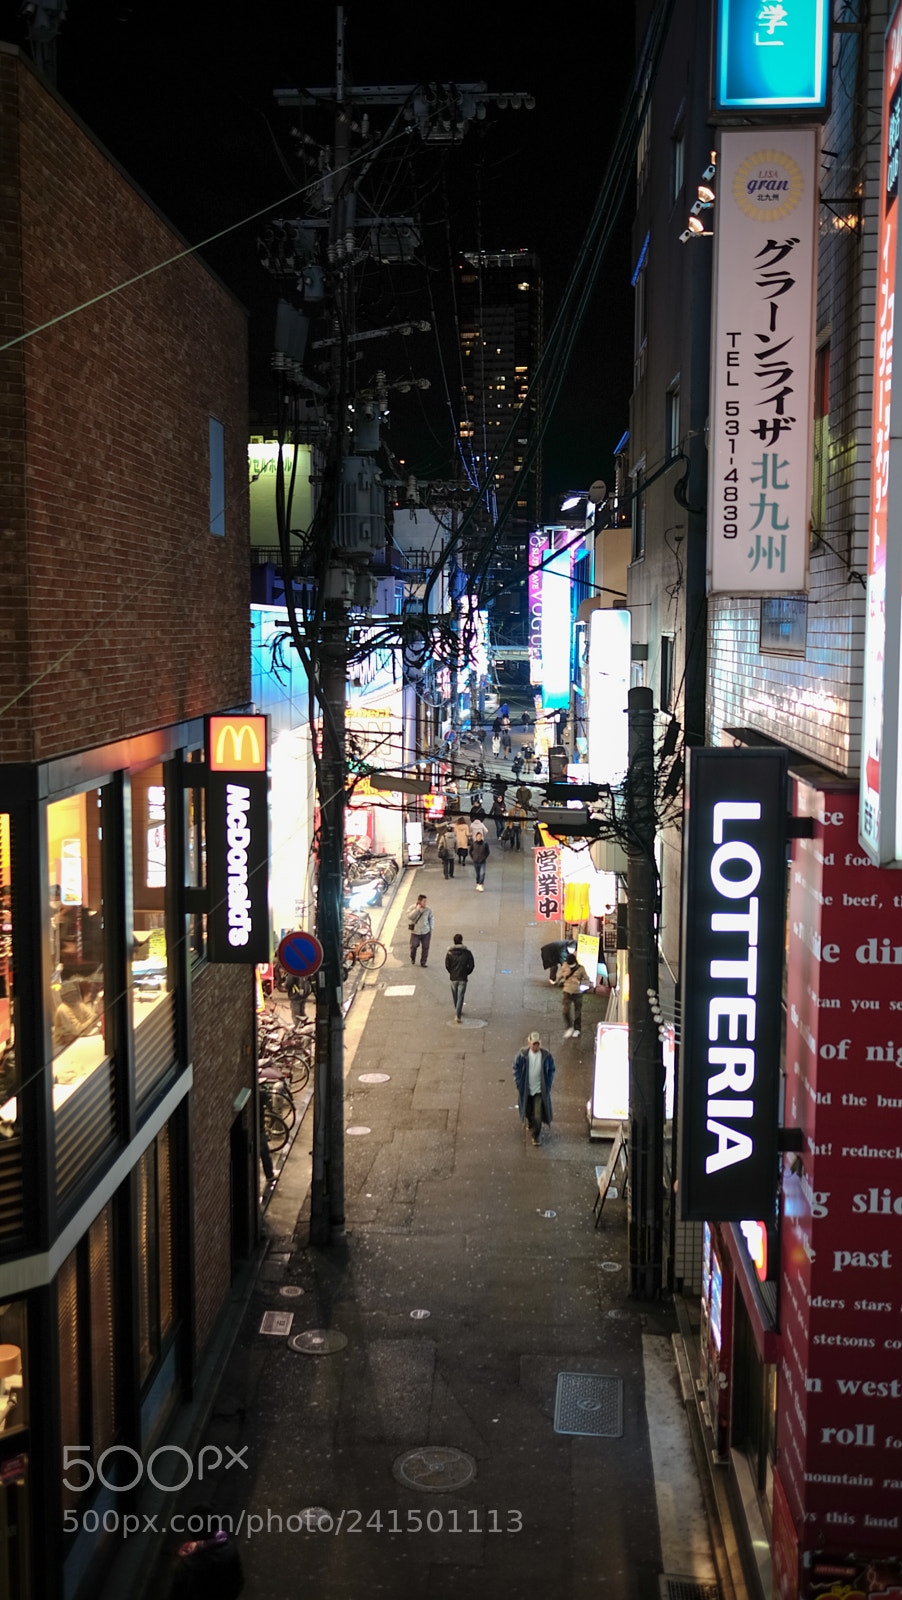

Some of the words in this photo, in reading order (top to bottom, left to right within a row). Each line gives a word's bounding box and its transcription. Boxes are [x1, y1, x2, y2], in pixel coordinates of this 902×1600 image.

[756, 0, 788, 46] 学」
[747, 179, 789, 195] gran
[757, 194, 779, 202] 北九州
[749, 237, 801, 448] グラーンライザ
[726, 332, 742, 387] TEL
[723, 400, 740, 539] 531-4839
[747, 453, 791, 574] 北九州
[226, 783, 251, 947] McDonald's
[537, 848, 558, 918] 営業中
[843, 893, 883, 909] beef,
[705, 801, 762, 1174] LOTTERIA
[851, 999, 880, 1013] you
[820, 1038, 852, 1060] of
[841, 1093, 868, 1107] the
[833, 1249, 893, 1272] past
[853, 1299, 893, 1312] stars
[812, 1333, 876, 1348] stetsons
[819, 1423, 876, 1447] roll
[825, 1511, 856, 1525] this
